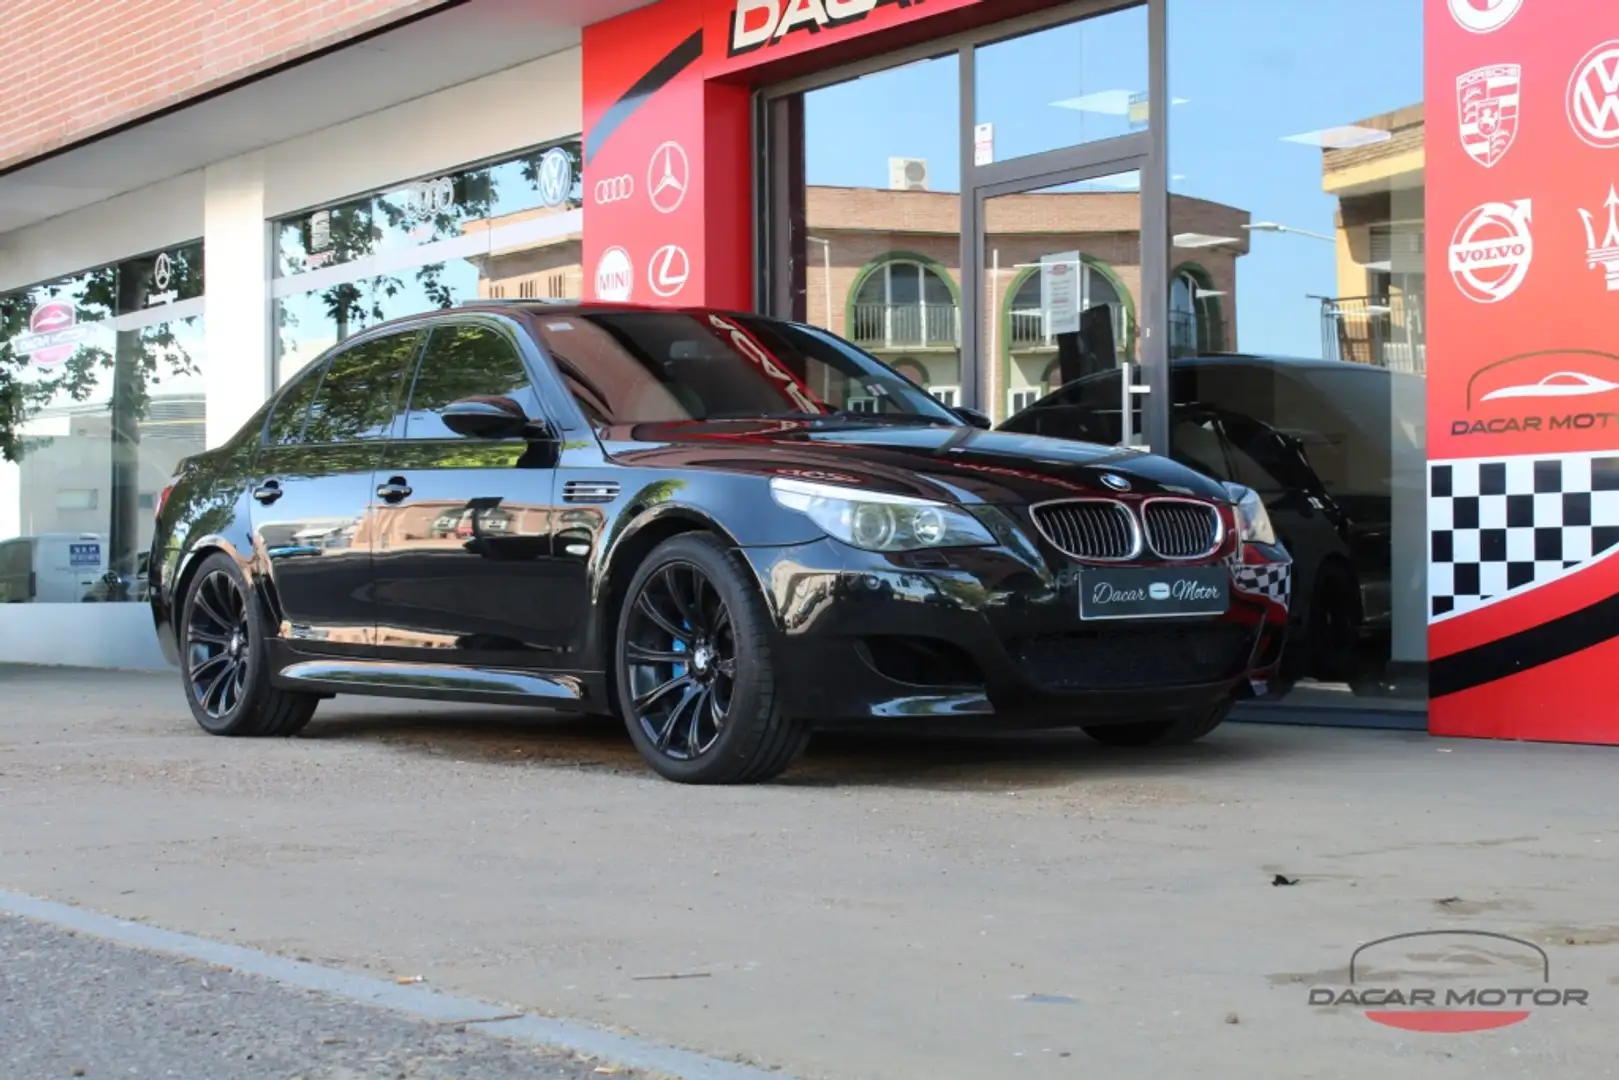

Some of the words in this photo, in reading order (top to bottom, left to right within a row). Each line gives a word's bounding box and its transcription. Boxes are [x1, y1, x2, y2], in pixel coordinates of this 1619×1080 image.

[1456, 244, 1525, 263] VOLVO
[600, 269, 629, 291] MINI
[1451, 416, 1543, 436] DACAR
[1549, 412, 1619, 431] MOT
[1092, 581, 1147, 604] Dacar
[1171, 579, 1220, 600] Motor
